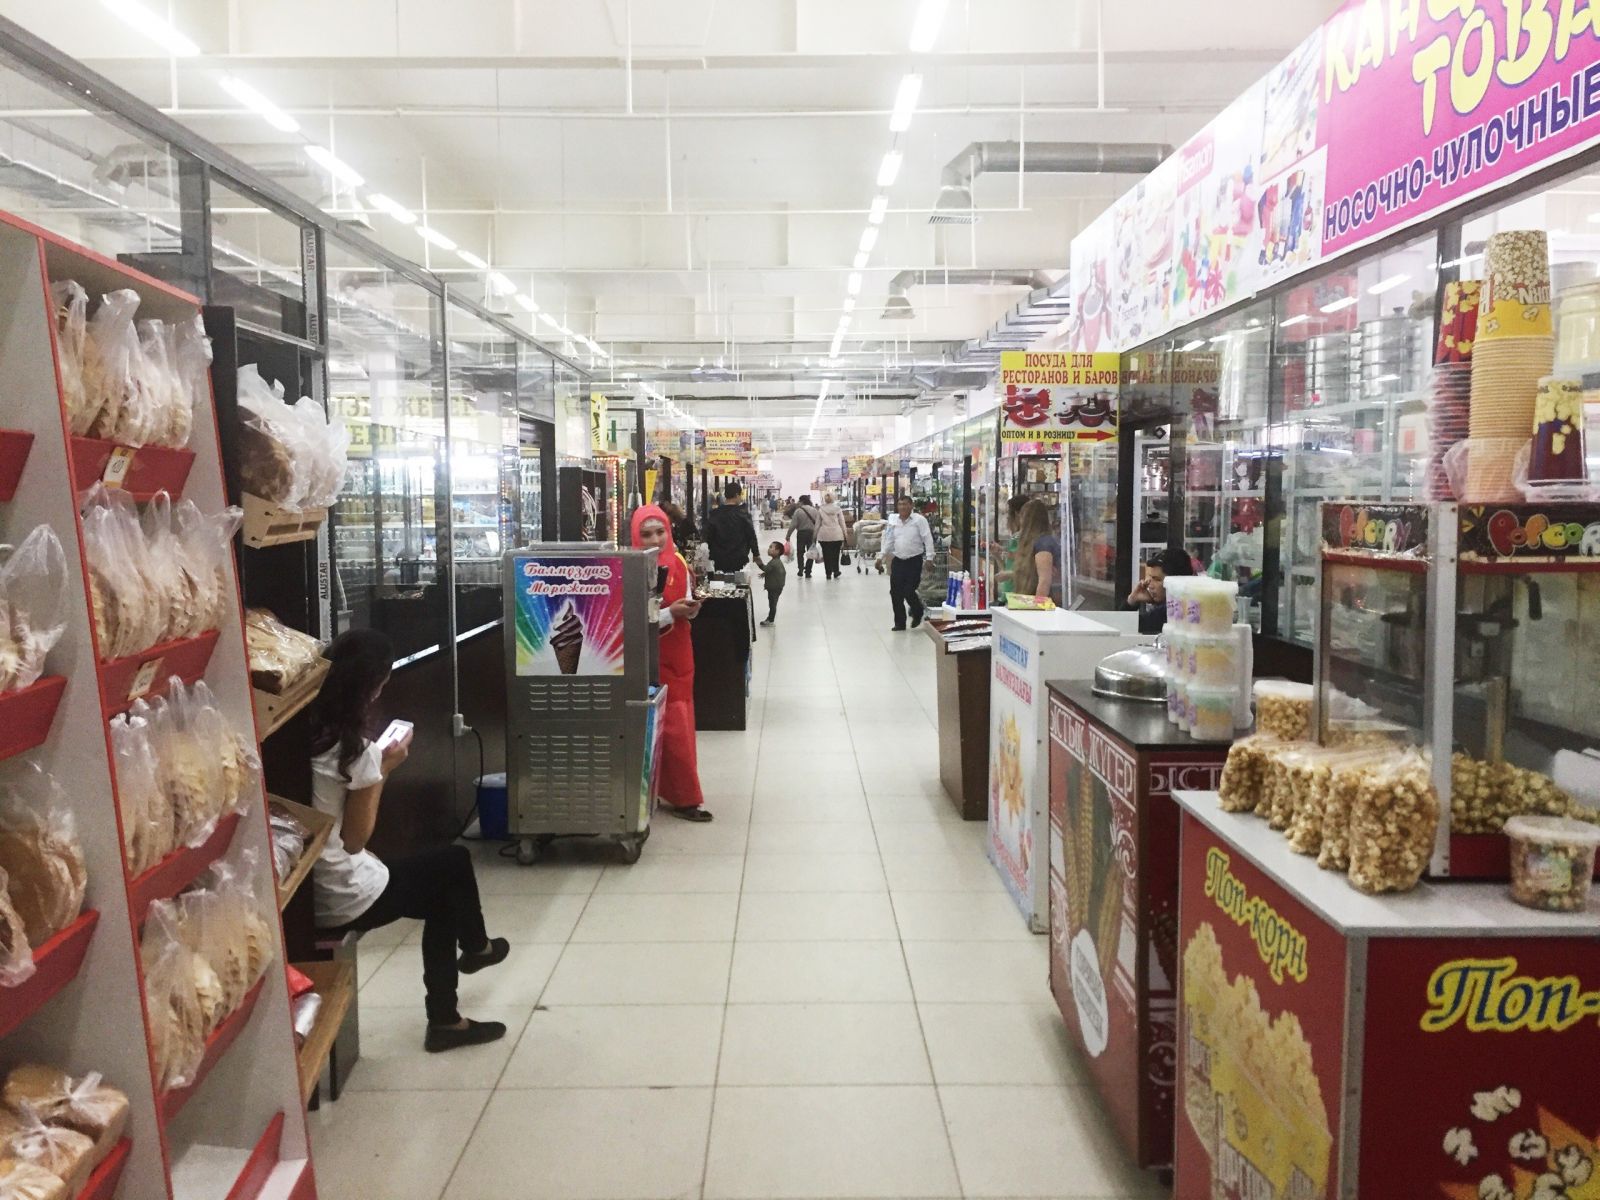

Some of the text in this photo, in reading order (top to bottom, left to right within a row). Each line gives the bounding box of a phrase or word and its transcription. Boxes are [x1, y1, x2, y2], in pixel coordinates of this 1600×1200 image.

[304, 231, 316, 271] ALUSTAR
[1025, 354, 1093, 368] ПОСУДА ДЛЯ
[1003, 370, 1118, 384] РЕСТОРАНОВ И БАРОВ
[1001, 431, 1075, 440] ОПТОМ И В РОЗНИЦУ
[320, 562, 328, 600] ALUSTAR
[527, 580, 609, 597] Мороженое
[1205, 847, 1307, 985] Поп-корн
